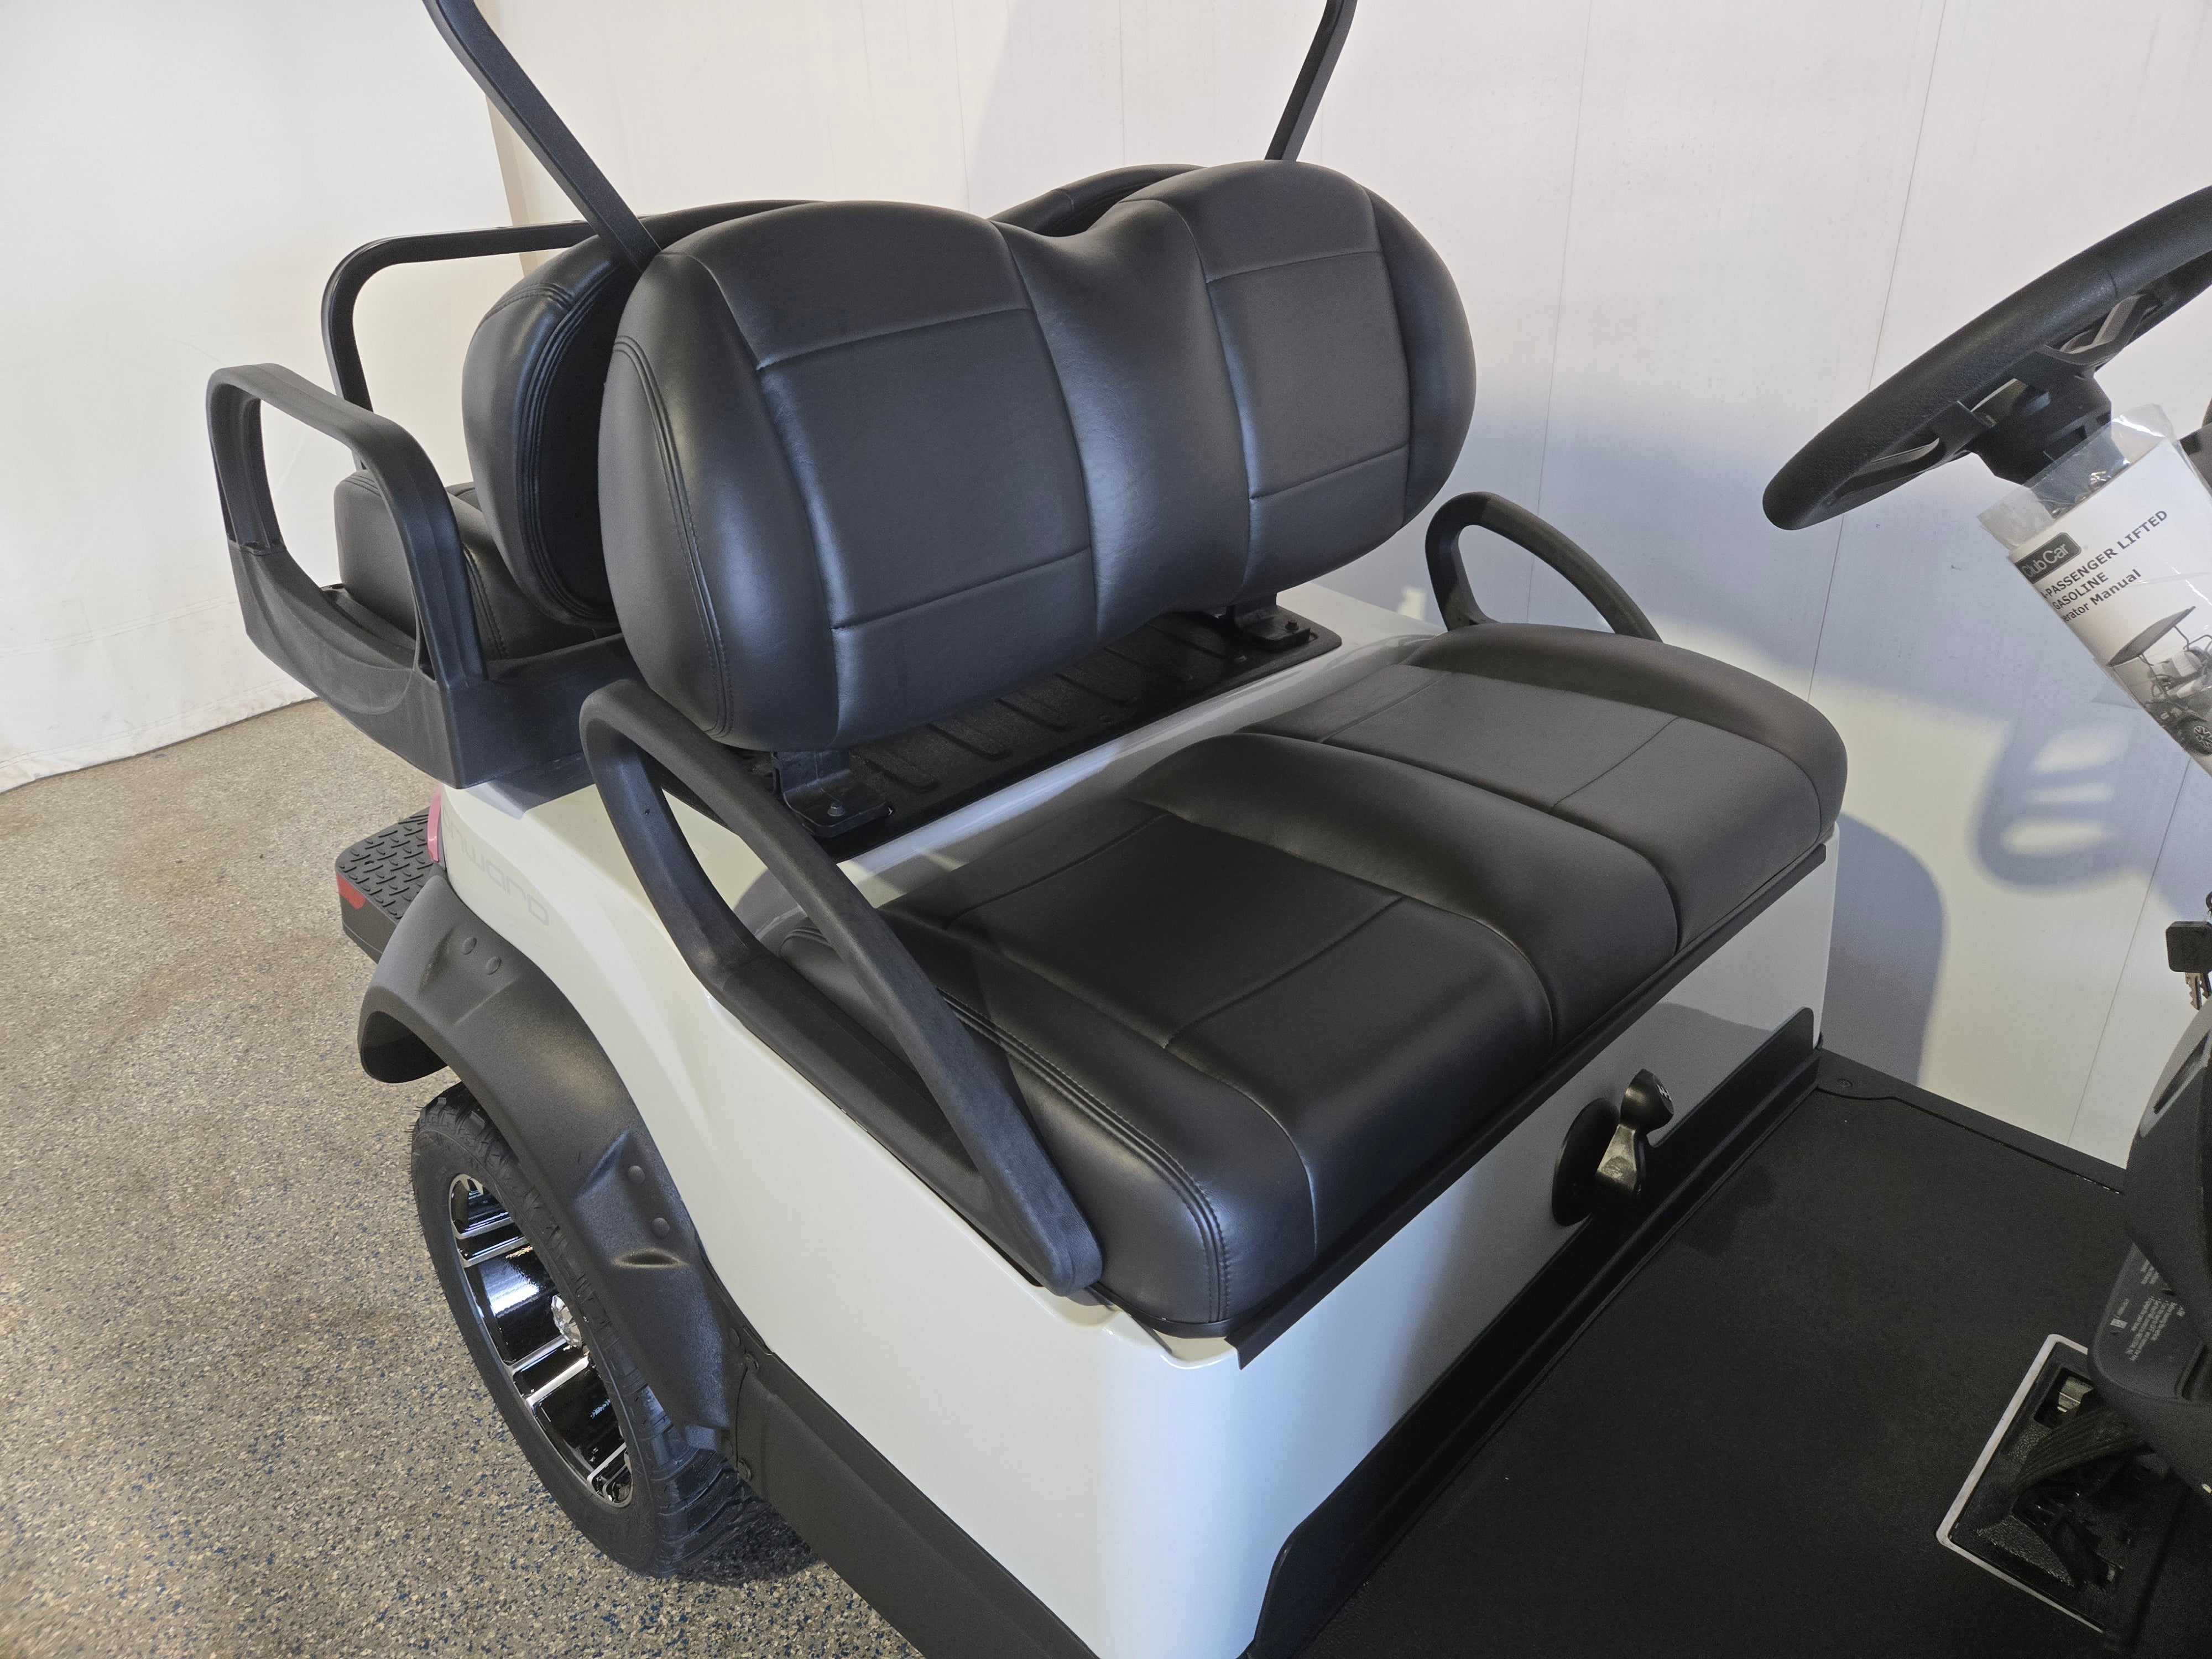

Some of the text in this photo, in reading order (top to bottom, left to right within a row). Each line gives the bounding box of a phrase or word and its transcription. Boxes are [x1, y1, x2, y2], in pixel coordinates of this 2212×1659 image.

[2117, 510, 2167, 549] LIFTED
[2021, 544, 2069, 577] Club Car
[2052, 571, 2109, 610] GASOLINE
[2063, 568, 2142, 622] erator Manual
